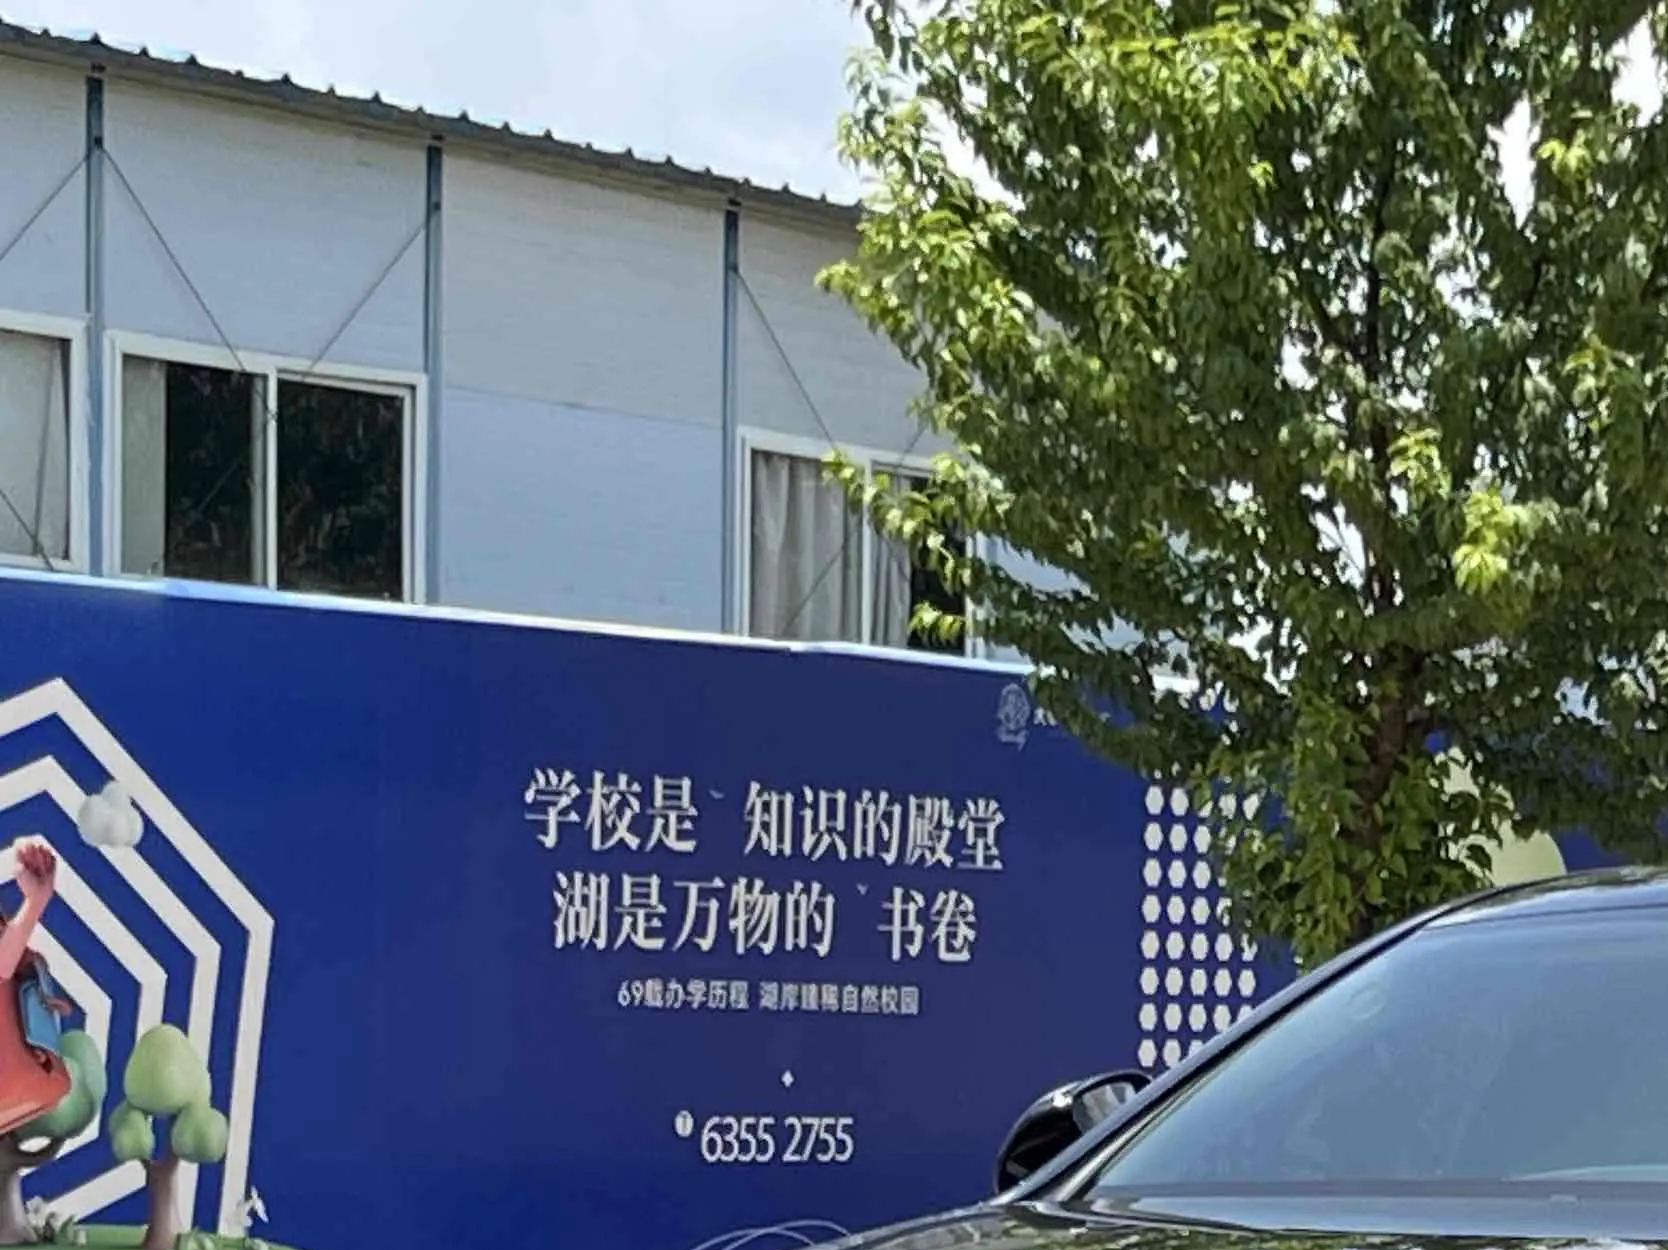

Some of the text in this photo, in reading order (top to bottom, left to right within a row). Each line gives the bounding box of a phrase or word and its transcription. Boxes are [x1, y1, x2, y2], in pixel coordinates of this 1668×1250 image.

[524, 767, 1005, 870] 学校是 知识的殿堂
[553, 871, 976, 962] 湖是万物的 书卷
[701, 1115, 854, 1163] 6355 2755
